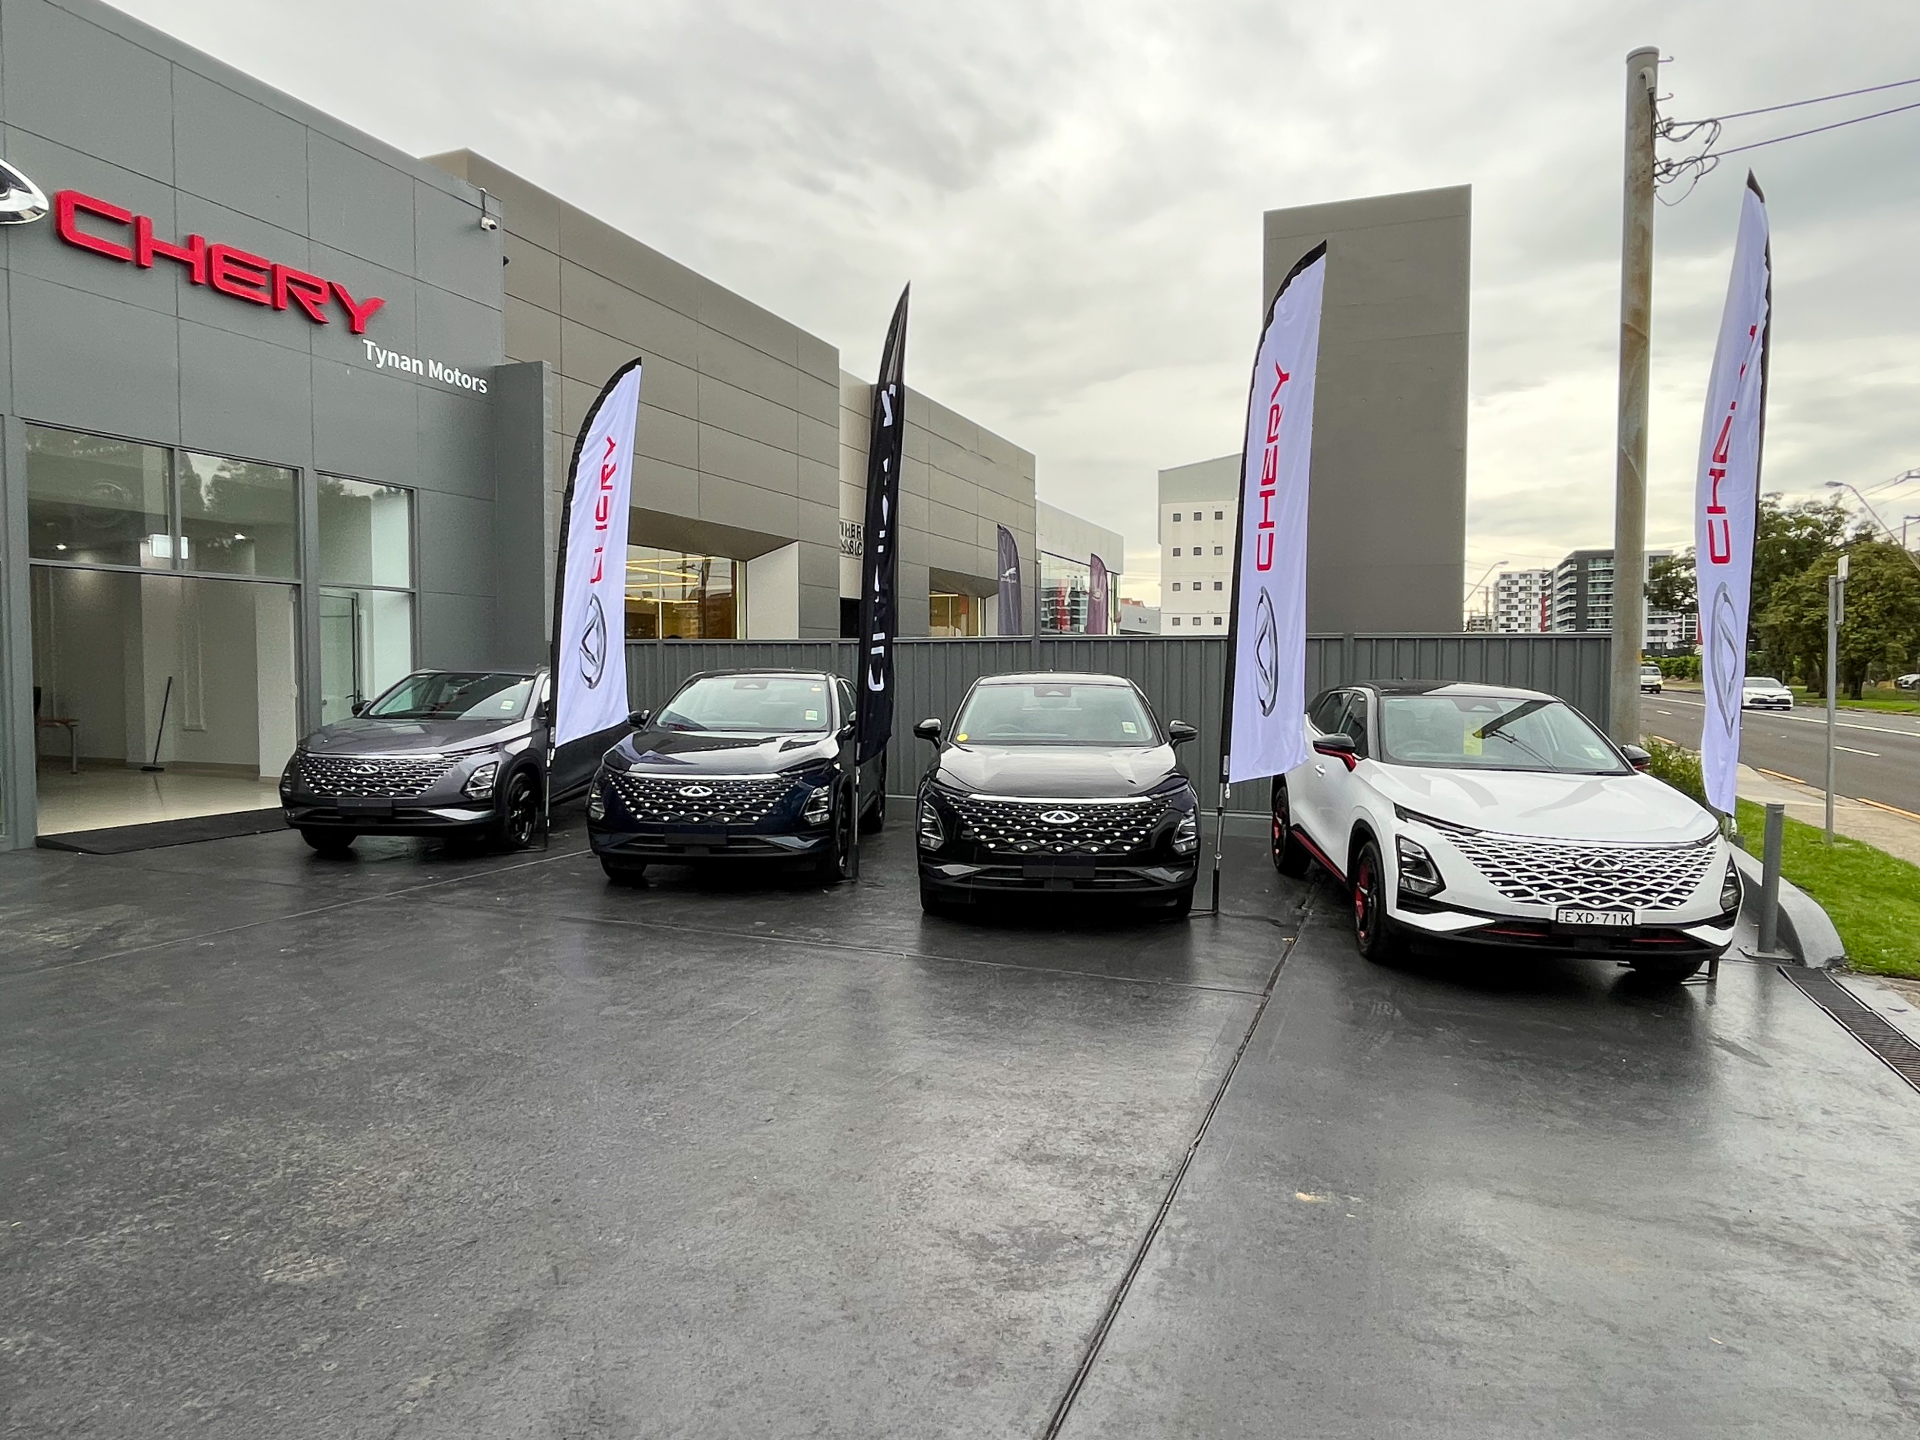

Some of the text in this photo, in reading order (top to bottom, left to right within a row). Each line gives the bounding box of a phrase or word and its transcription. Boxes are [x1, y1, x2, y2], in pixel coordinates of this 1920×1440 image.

[55, 189, 387, 335] CHERY
[362, 338, 488, 394] Tynan Motors
[1256, 359, 1290, 572] CHERY
